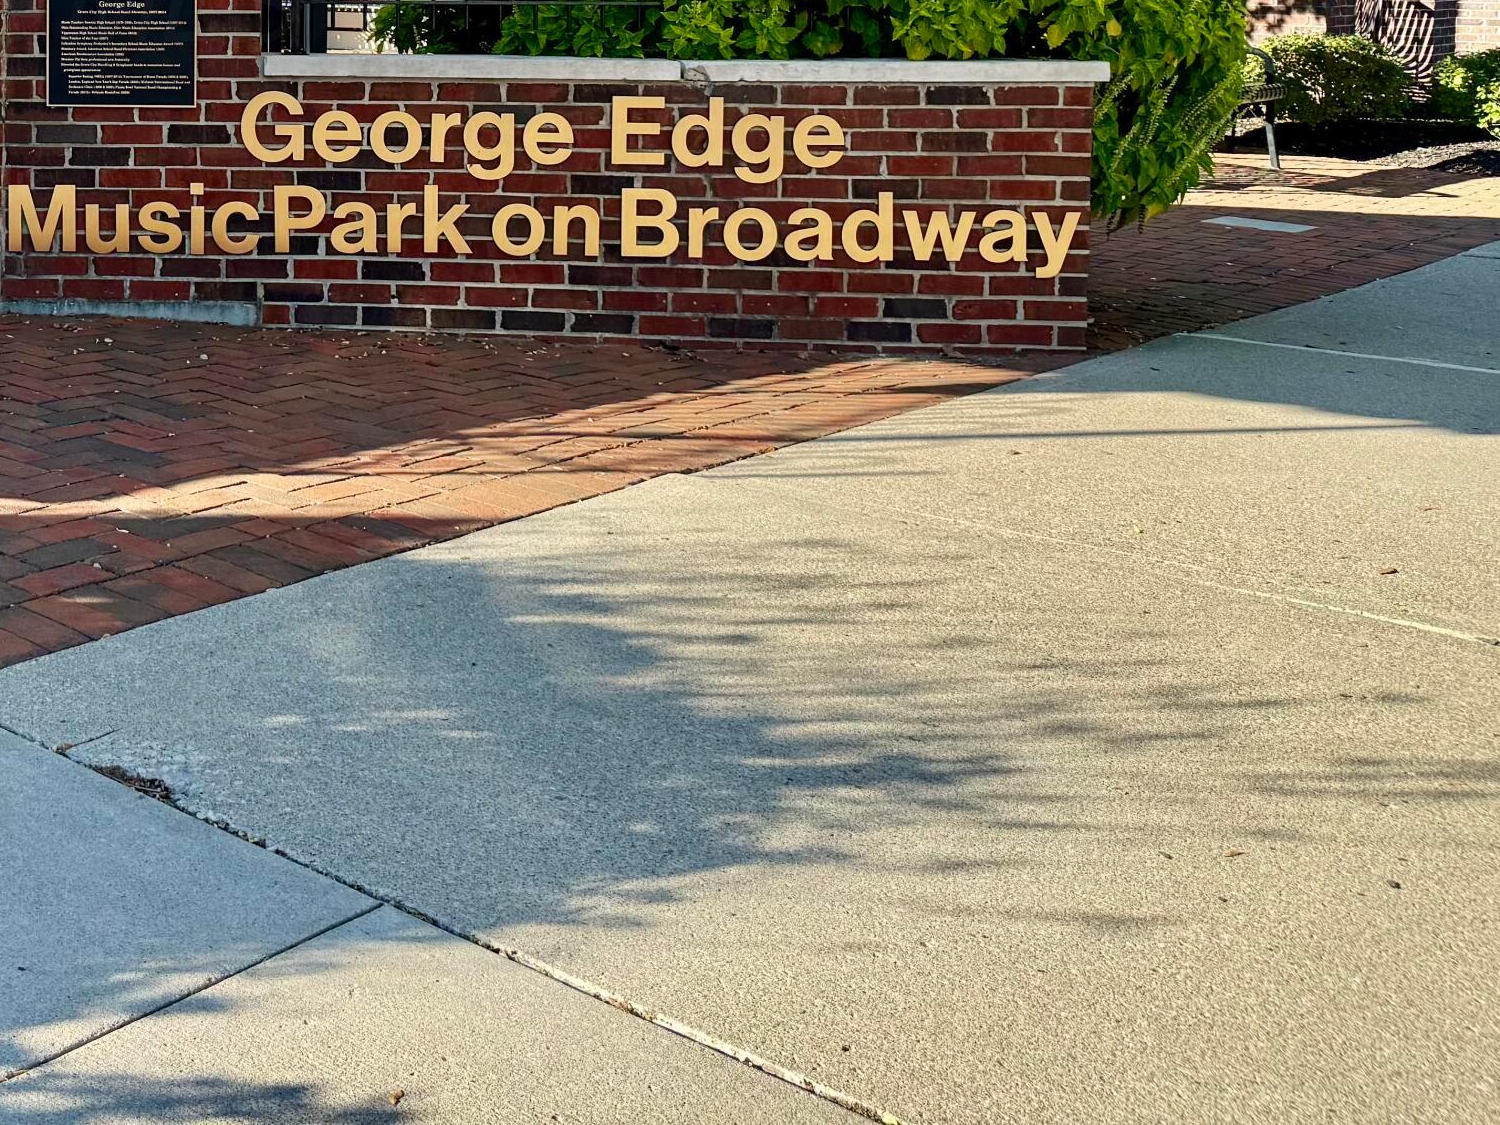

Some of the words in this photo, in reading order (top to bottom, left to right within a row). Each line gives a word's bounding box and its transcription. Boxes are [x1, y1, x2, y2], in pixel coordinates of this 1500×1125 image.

[98, 0, 125, 8] George
[239, 90, 575, 181] George
[611, 95, 847, 184] Edge
[7, 181, 260, 255] Music
[274, 184, 473, 255] Park
[491, 200, 600, 257] on
[620, 187, 1082, 279] Broadway
